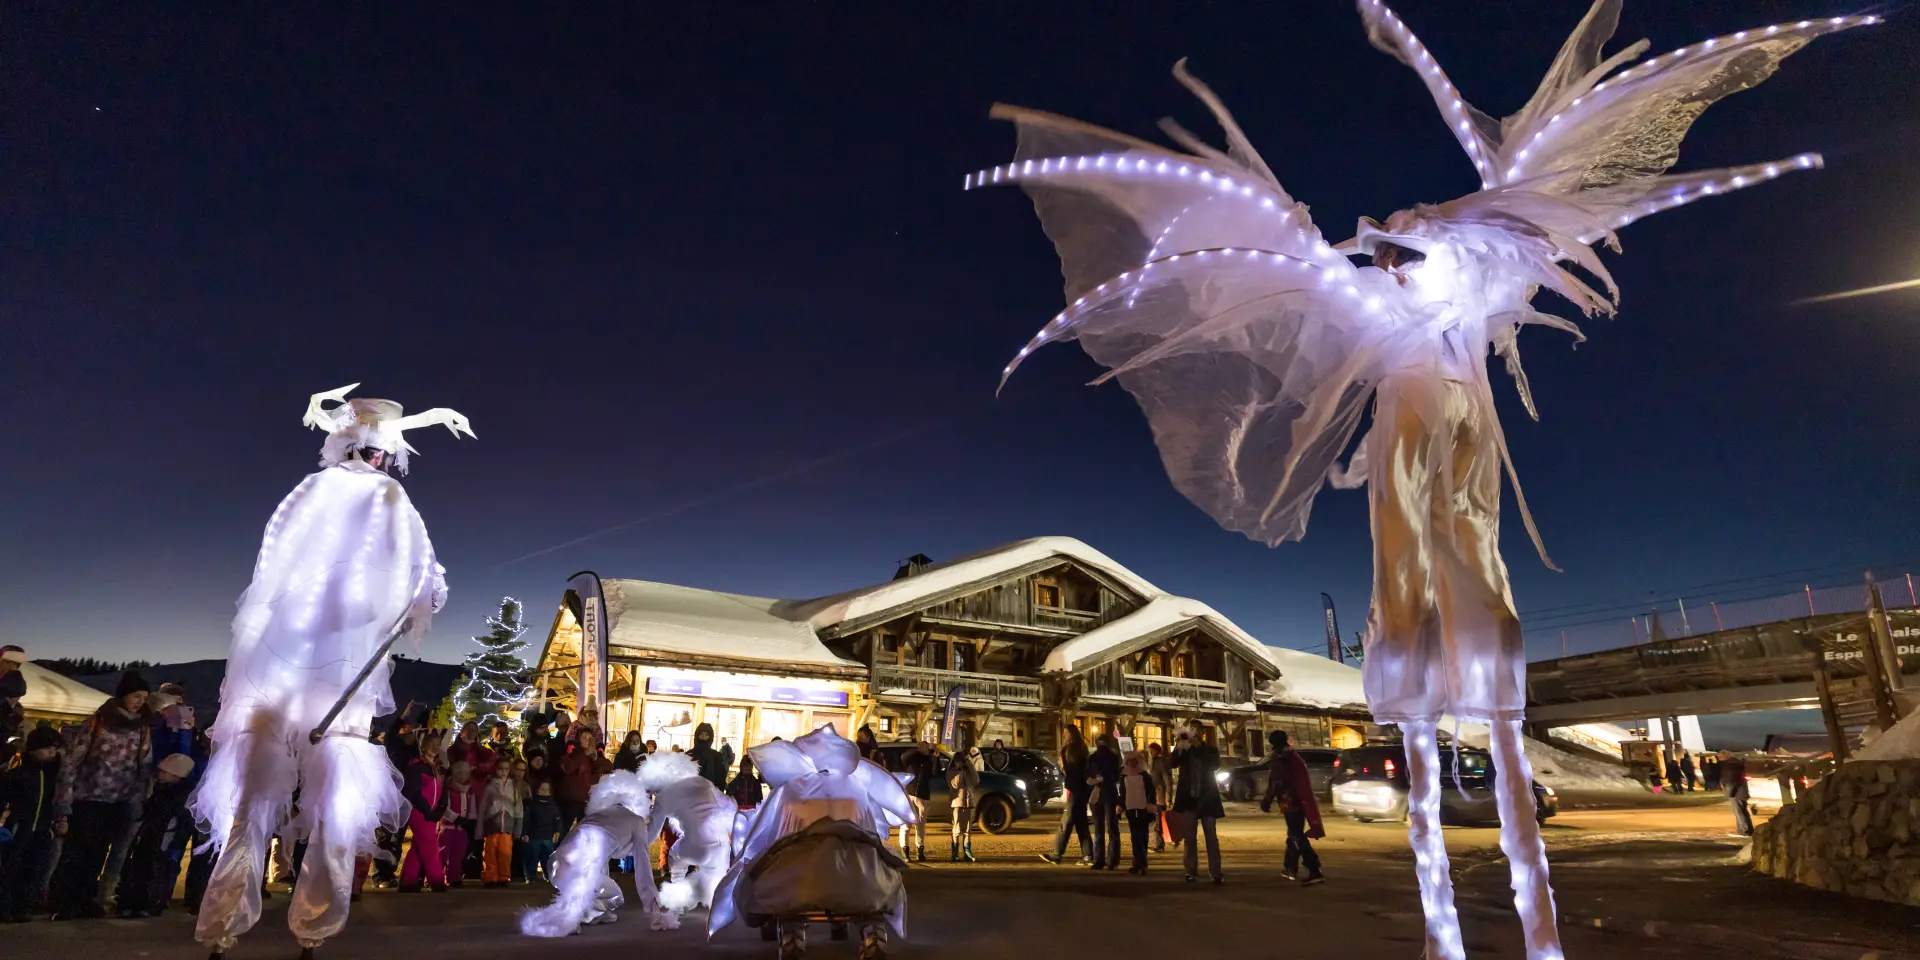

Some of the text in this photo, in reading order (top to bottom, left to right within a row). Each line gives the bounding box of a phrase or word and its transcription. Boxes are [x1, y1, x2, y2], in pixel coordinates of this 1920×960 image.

[1836, 627, 1920, 643] Le ais
[1824, 650, 1863, 661] Espa
